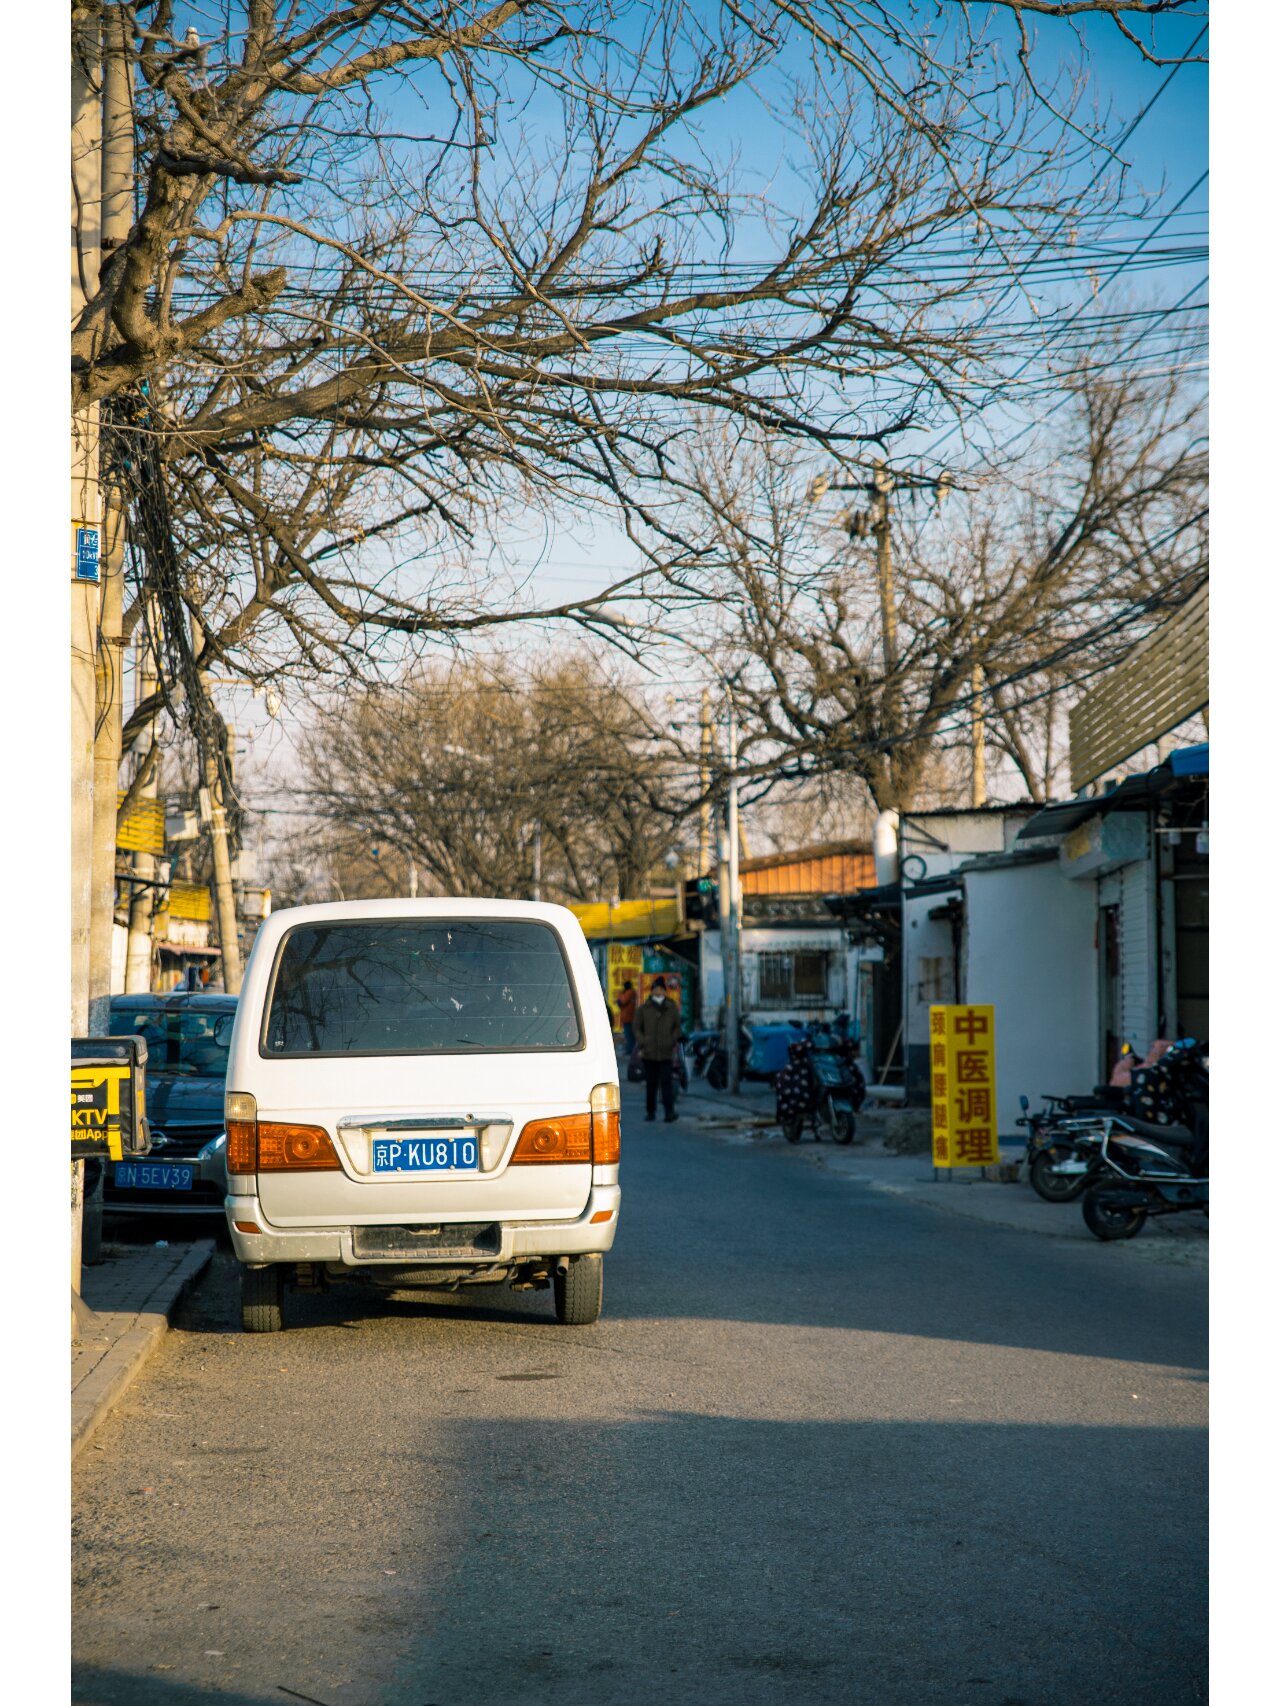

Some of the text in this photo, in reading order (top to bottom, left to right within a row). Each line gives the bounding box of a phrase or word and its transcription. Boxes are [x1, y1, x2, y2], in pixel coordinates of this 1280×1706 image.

[954, 1009, 993, 1163] 中医调理
[71, 1108, 108, 1125] KTV
[376, 1142, 475, 1167] 京P·KU810
